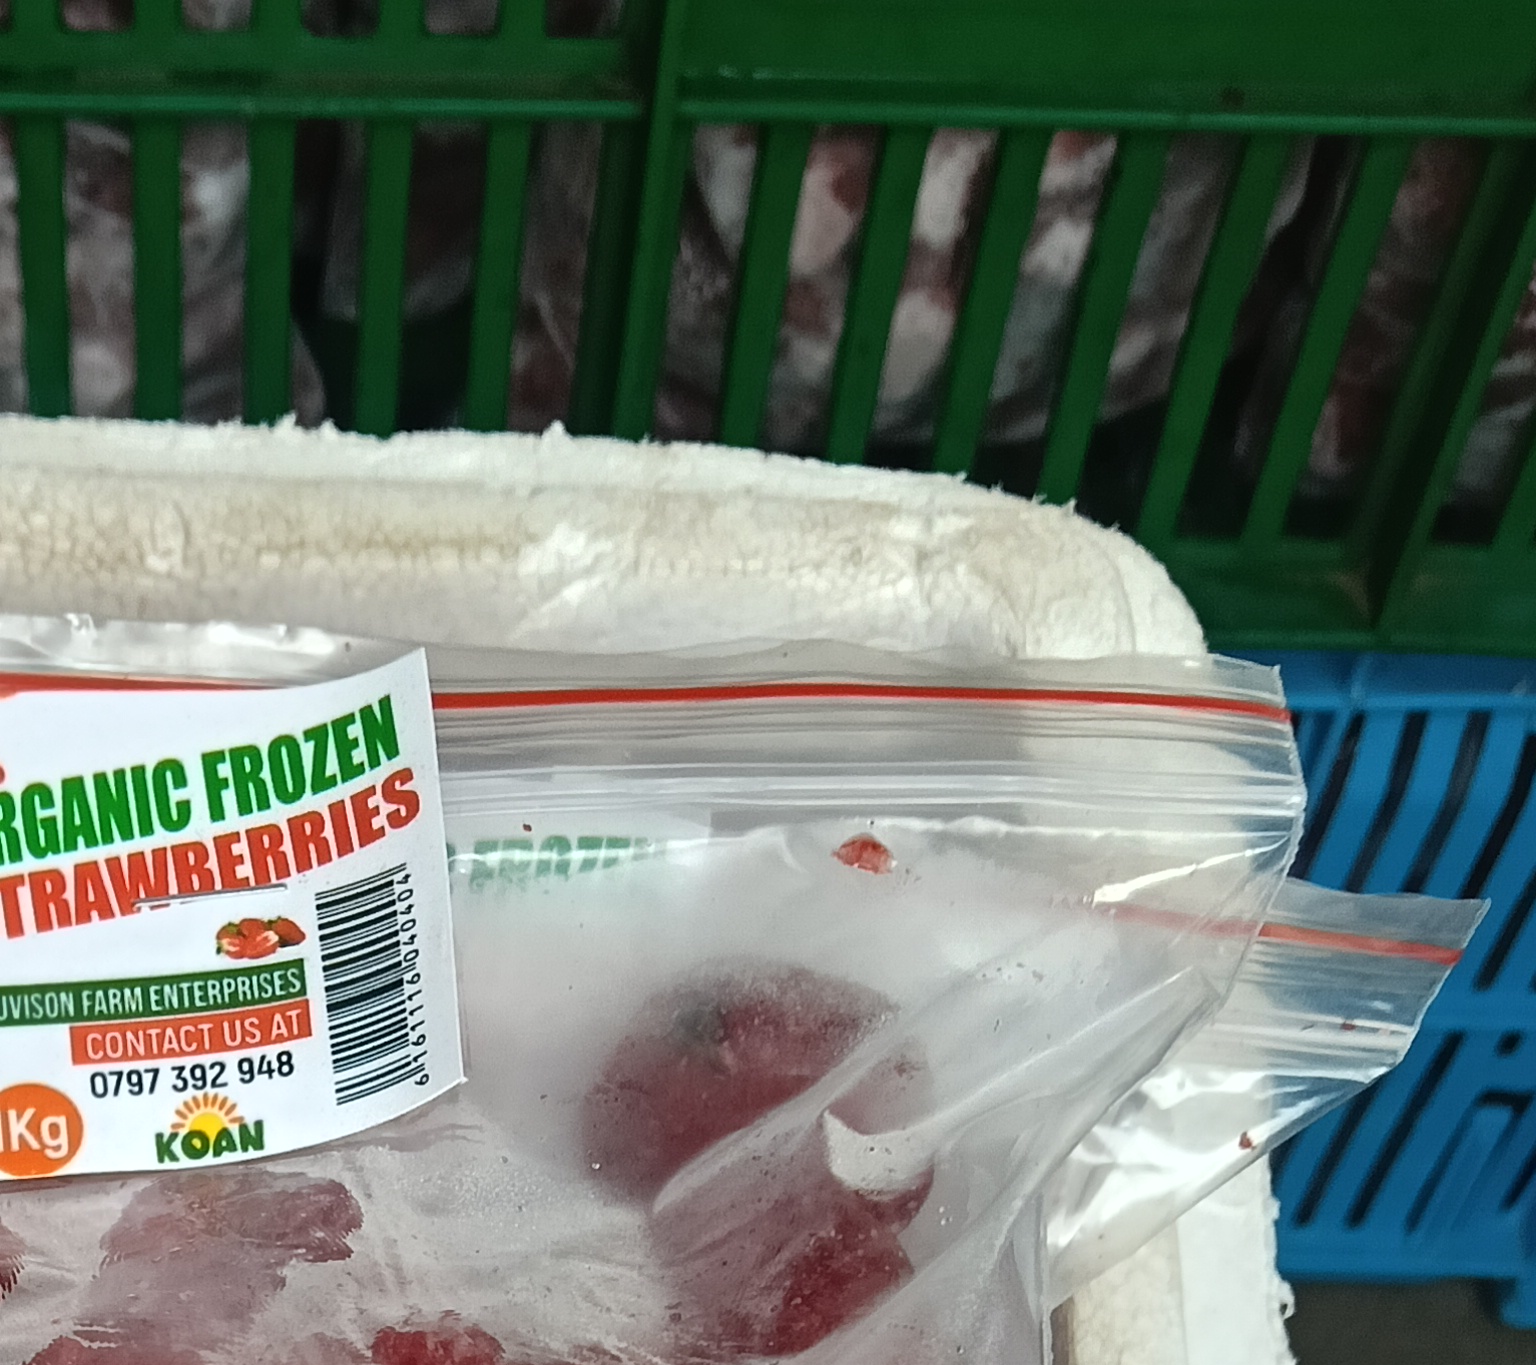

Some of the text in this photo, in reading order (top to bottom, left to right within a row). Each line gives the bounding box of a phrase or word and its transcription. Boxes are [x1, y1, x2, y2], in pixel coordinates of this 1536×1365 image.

[201, 694, 401, 823] FROZEN
[82, 984, 143, 1017] FARM
[150, 967, 302, 1012] ENTERPRISES
[85, 1008, 303, 1061] CONTACT US AT
[89, 1050, 295, 1099] 0797 392 948
[154, 1119, 265, 1164] KOAN
